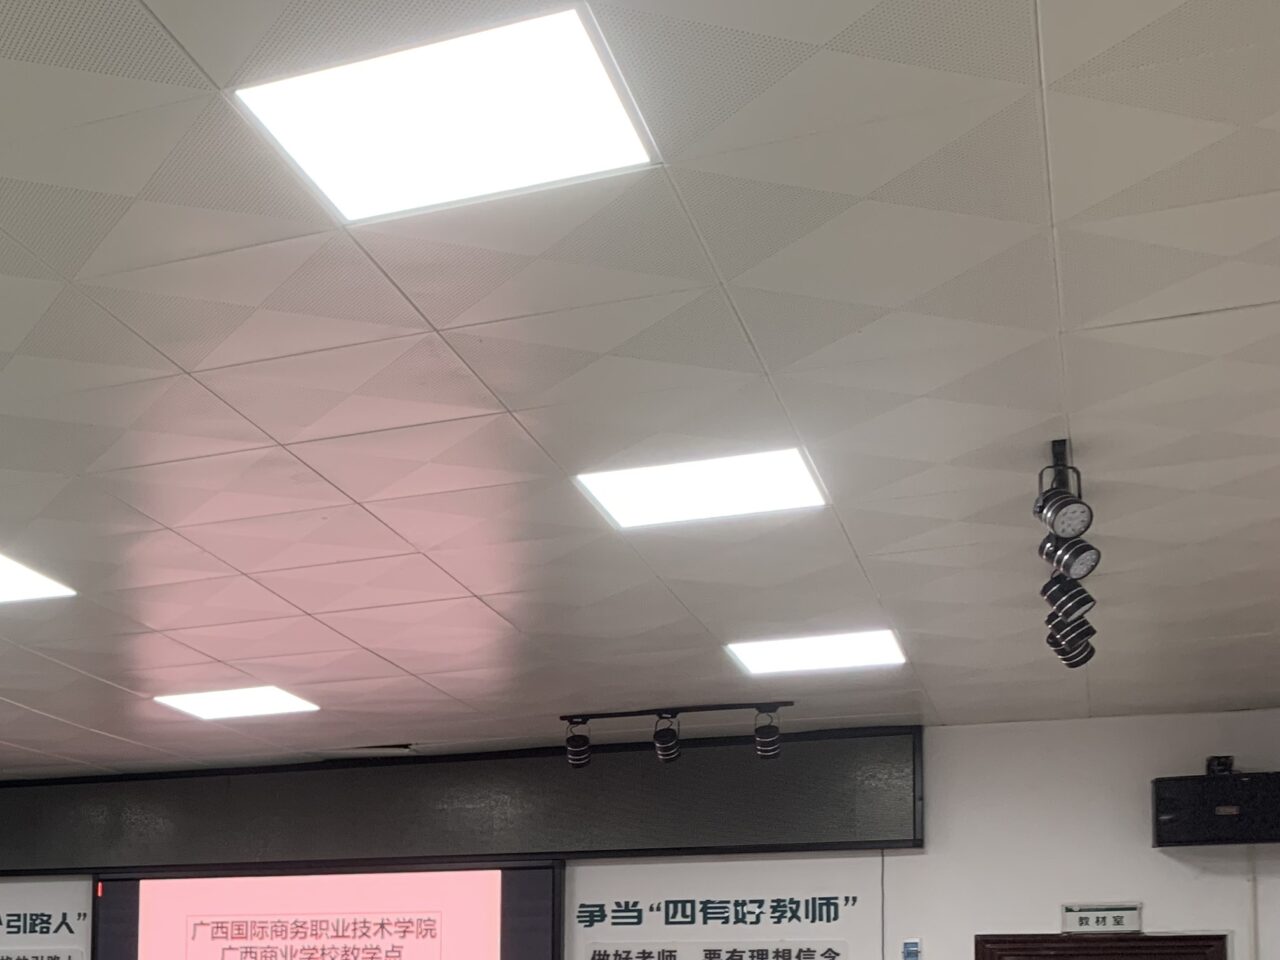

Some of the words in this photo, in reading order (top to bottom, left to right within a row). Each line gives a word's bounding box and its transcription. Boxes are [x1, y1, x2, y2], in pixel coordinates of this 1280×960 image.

[576, 895, 859, 928] 争当“四有好教师”
[1078, 915, 1125, 927] 教材室
[192, 917, 438, 942] 广西国际商务职业技术学院
